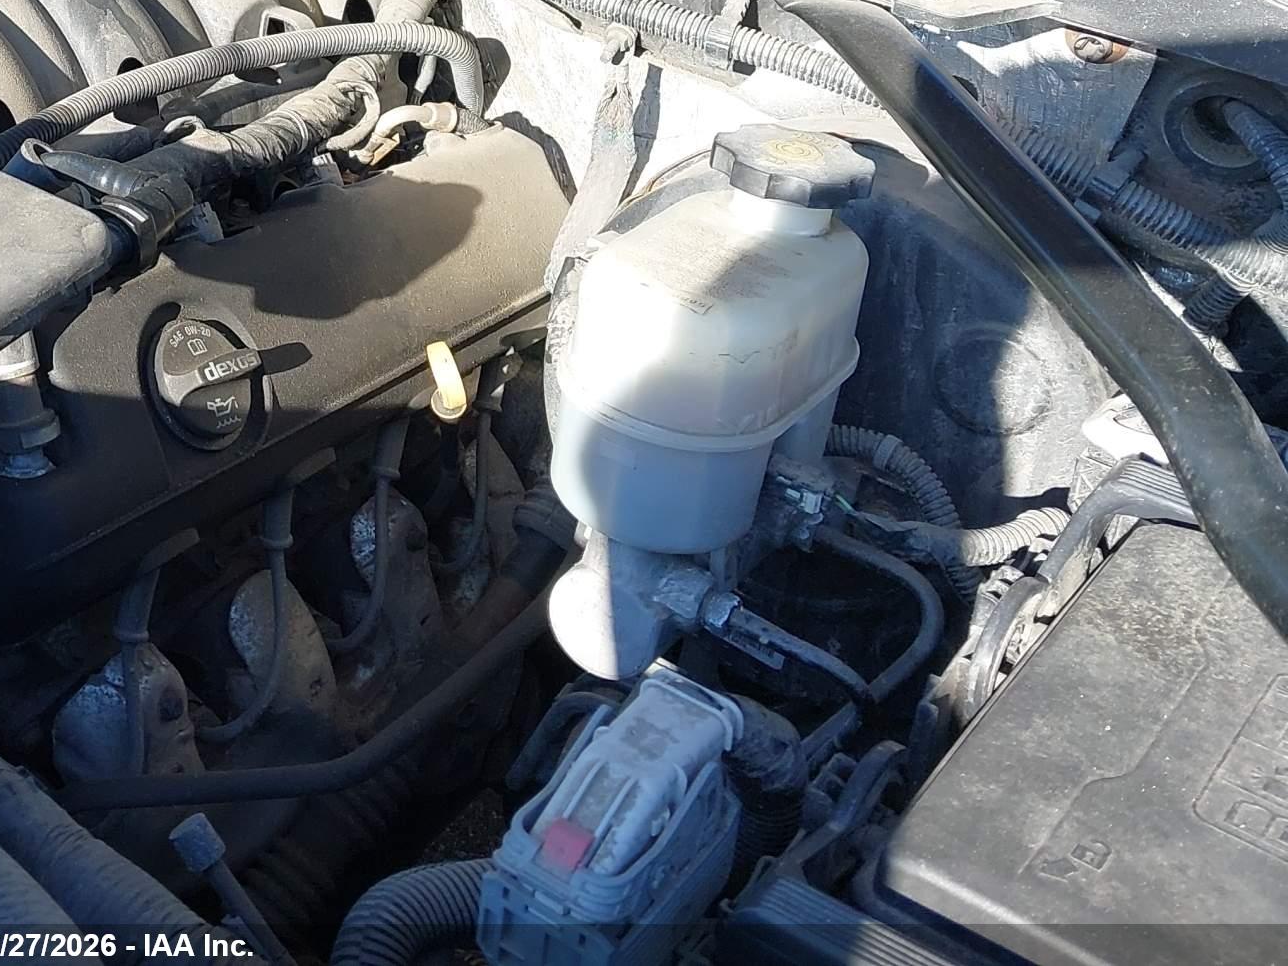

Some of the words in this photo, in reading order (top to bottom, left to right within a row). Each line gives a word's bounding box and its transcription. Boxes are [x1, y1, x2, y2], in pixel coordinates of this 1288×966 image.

[169, 331, 185, 348] SAE
[184, 325, 211, 338] 0W-20
[204, 354, 257, 381] dexos
